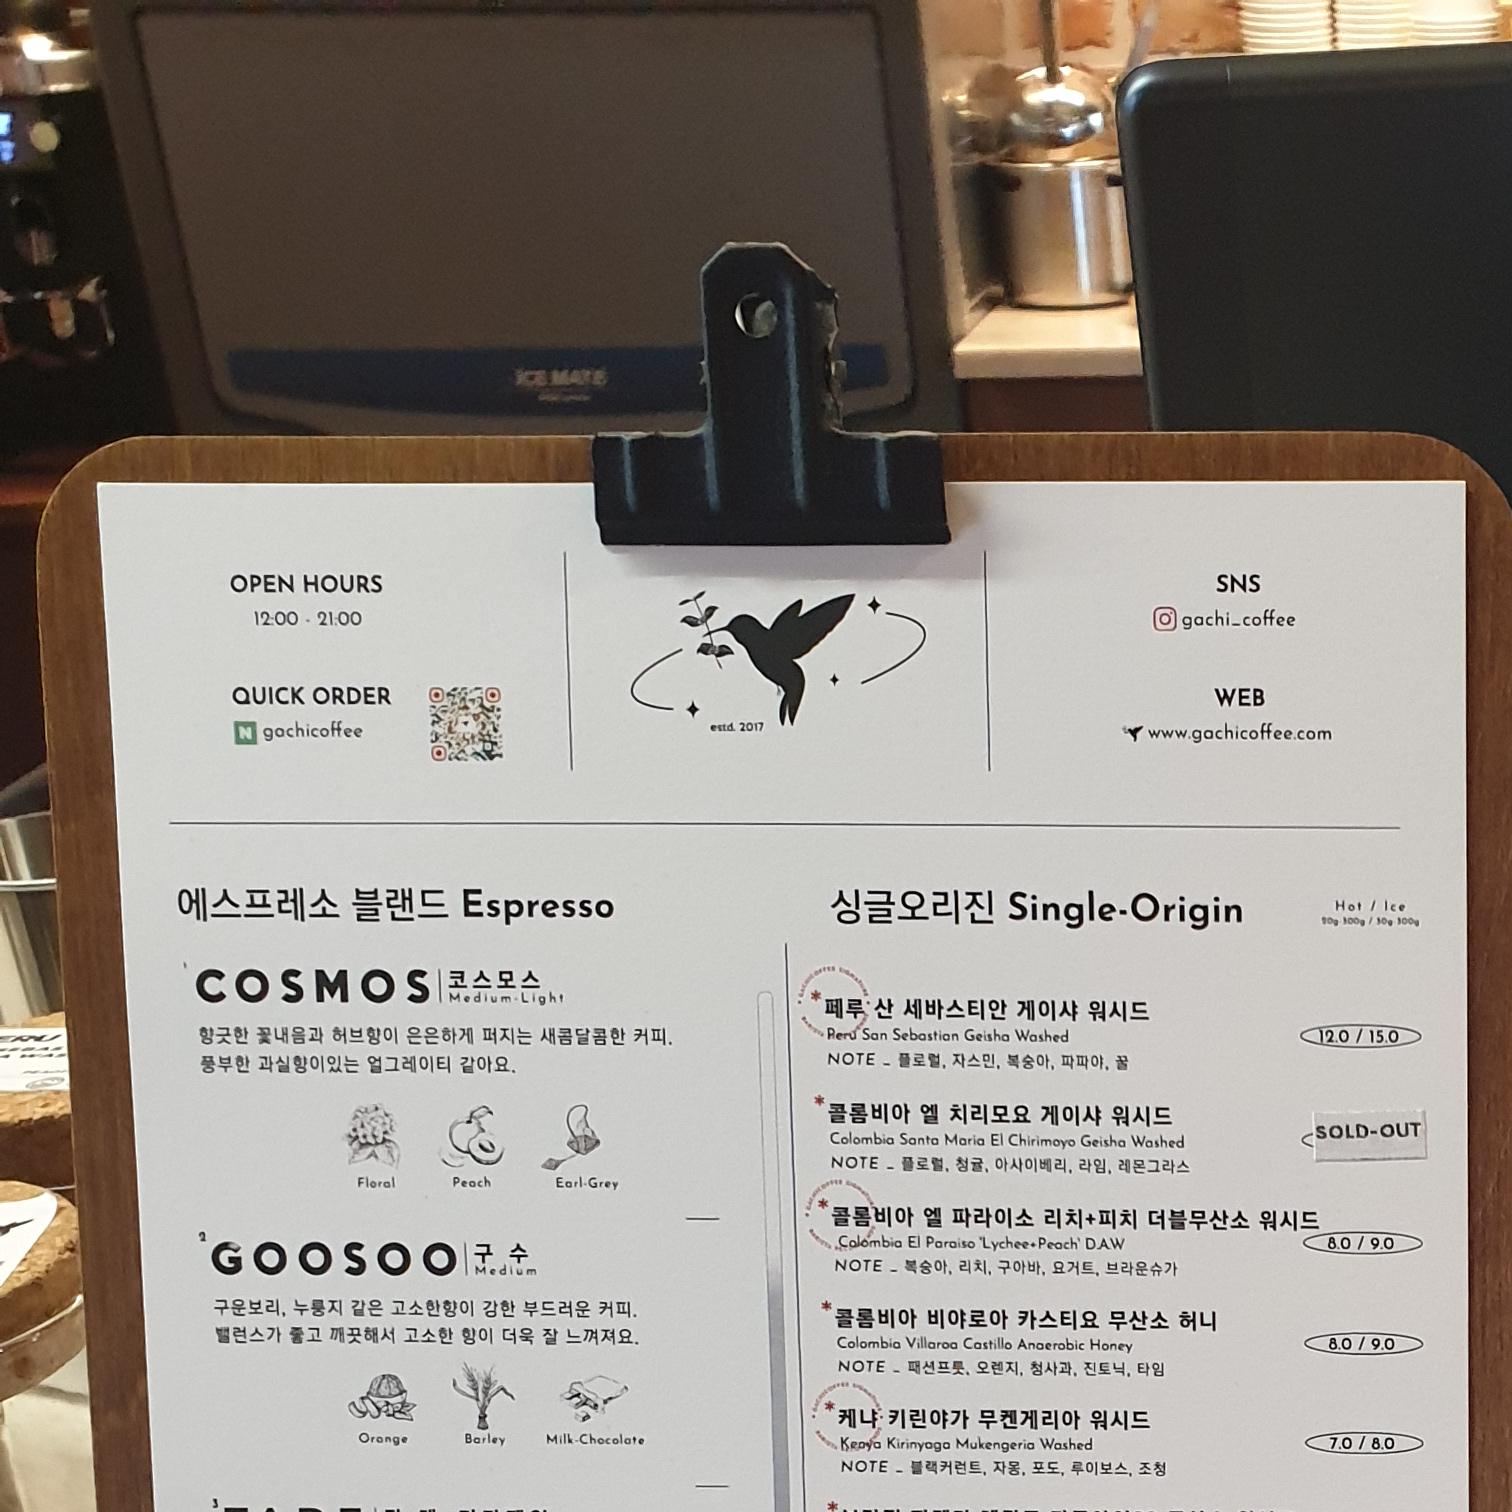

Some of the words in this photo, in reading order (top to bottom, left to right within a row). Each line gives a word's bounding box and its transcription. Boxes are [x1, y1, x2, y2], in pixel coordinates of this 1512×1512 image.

[230, 574, 294, 593] OPEN
[304, 574, 382, 593] HOURS
[1216, 574, 1260, 593] SNS
[254, 611, 298, 626] 12:00
[317, 611, 362, 626] 21:00
[1182, 609, 1295, 630] gachi_coffee
[232, 686, 305, 705] QUICK
[313, 687, 391, 705] ORDER
[1214, 688, 1265, 707] WEB
[263, 720, 363, 741] gachicoffee
[710, 722, 736, 731] estd.
[739, 722, 764, 732] 2017
[1148, 722, 1332, 743] www.gachicoffee.com
[178, 888, 340, 922] 에스프레소
[352, 888, 449, 922] 블랜드
[463, 889, 614, 925] Espresso
[831, 889, 994, 925] 싱글오리진
[1009, 890, 1242, 930] Single-Origin
[196, 969, 430, 1004] COSMOS
[448, 970, 540, 989] 코스모스
[199, 1026, 248, 1045] 향긋한
[257, 1027, 323, 1044] 꽃내음과
[332, 1027, 398, 1045] 허브향이
[406, 1027, 473, 1045] 은은하게
[482, 1027, 532, 1045] 퍼지는
[540, 1027, 626, 1045] 새콤달콤한
[634, 1027, 672, 1046] 커피.
[1319, 1029, 1349, 1043] 12.0
[1356, 1028, 1363, 1044] /
[1369, 1030, 1399, 1043] 15.0
[1316, 1121, 1426, 1139] SOLD-OUT
[358, 1176, 395, 1188] Floral
[453, 1176, 491, 1188] Peach
[556, 1176, 618, 1191] Earl-Grey
[211, 1242, 457, 1276] GOOSOO
[835, 1308, 917, 1329] 콜롬비아
[928, 1309, 1008, 1330] 비야로아
[1018, 1310, 1099, 1331] 카스티요
[1108, 1311, 1169, 1331] 무산소
[1179, 1311, 1216, 1332] 허니
[837, 1336, 901, 1349] Colombia
[905, 1336, 958, 1350] Villaroa
[963, 1337, 1012, 1350] Castillo
[1017, 1338, 1085, 1350] Anaerobic
[1090, 1338, 1133, 1354] Honey
[359, 1432, 408, 1446] Orange
[465, 1433, 505, 1446] Barley
[547, 1433, 644, 1445] Milk-Chocolate
